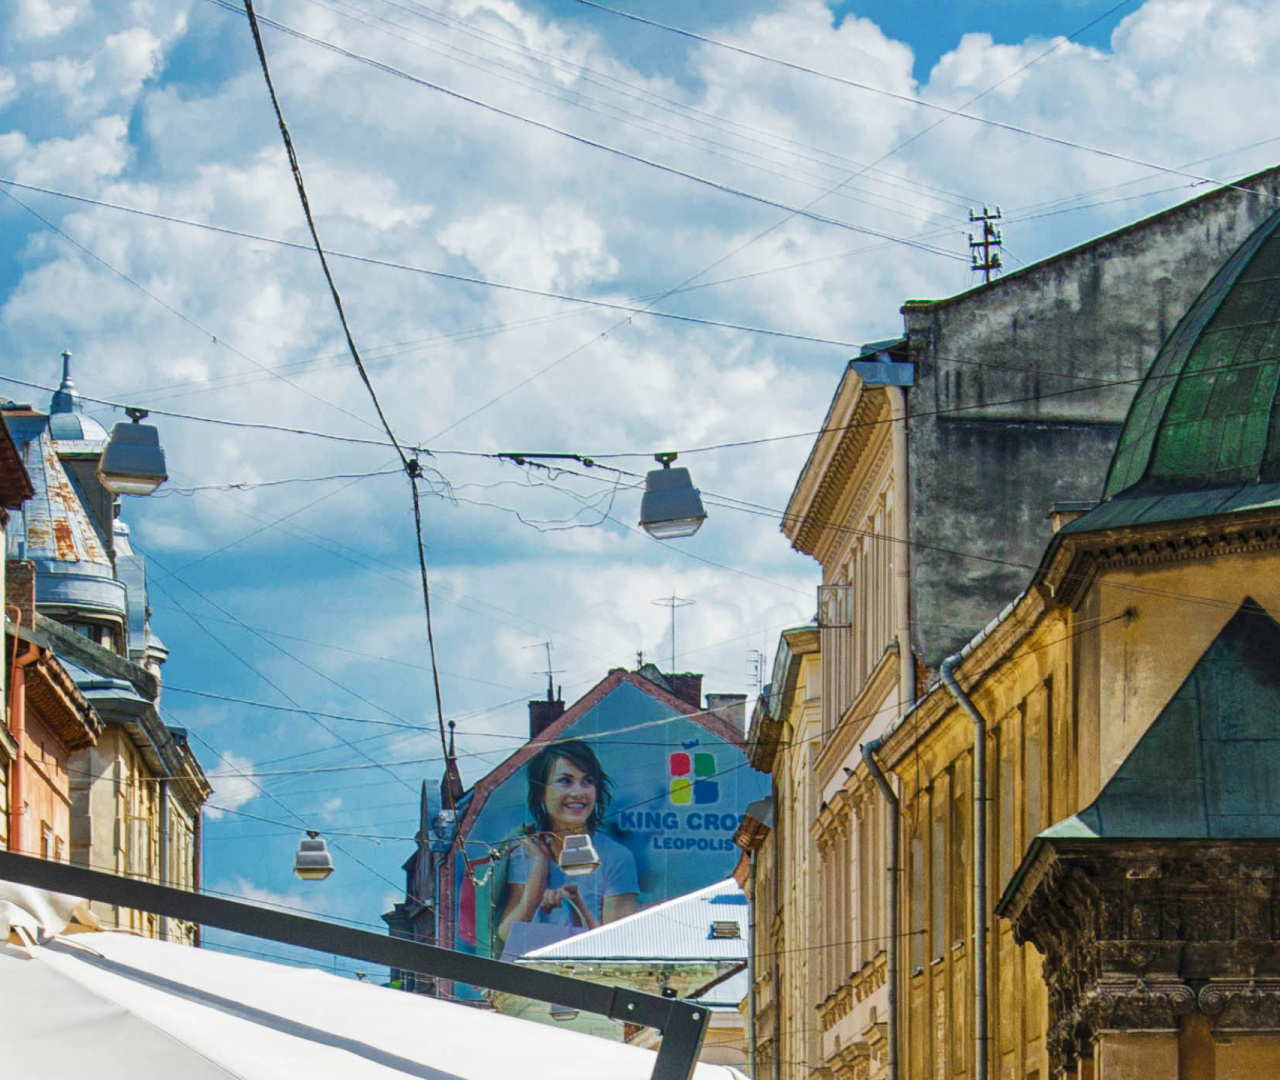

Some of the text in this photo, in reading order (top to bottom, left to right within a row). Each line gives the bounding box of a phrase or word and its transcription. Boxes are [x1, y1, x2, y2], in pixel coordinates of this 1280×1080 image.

[620, 812, 744, 831] KING CRO
[653, 837, 734, 851] LEOPOLIS
